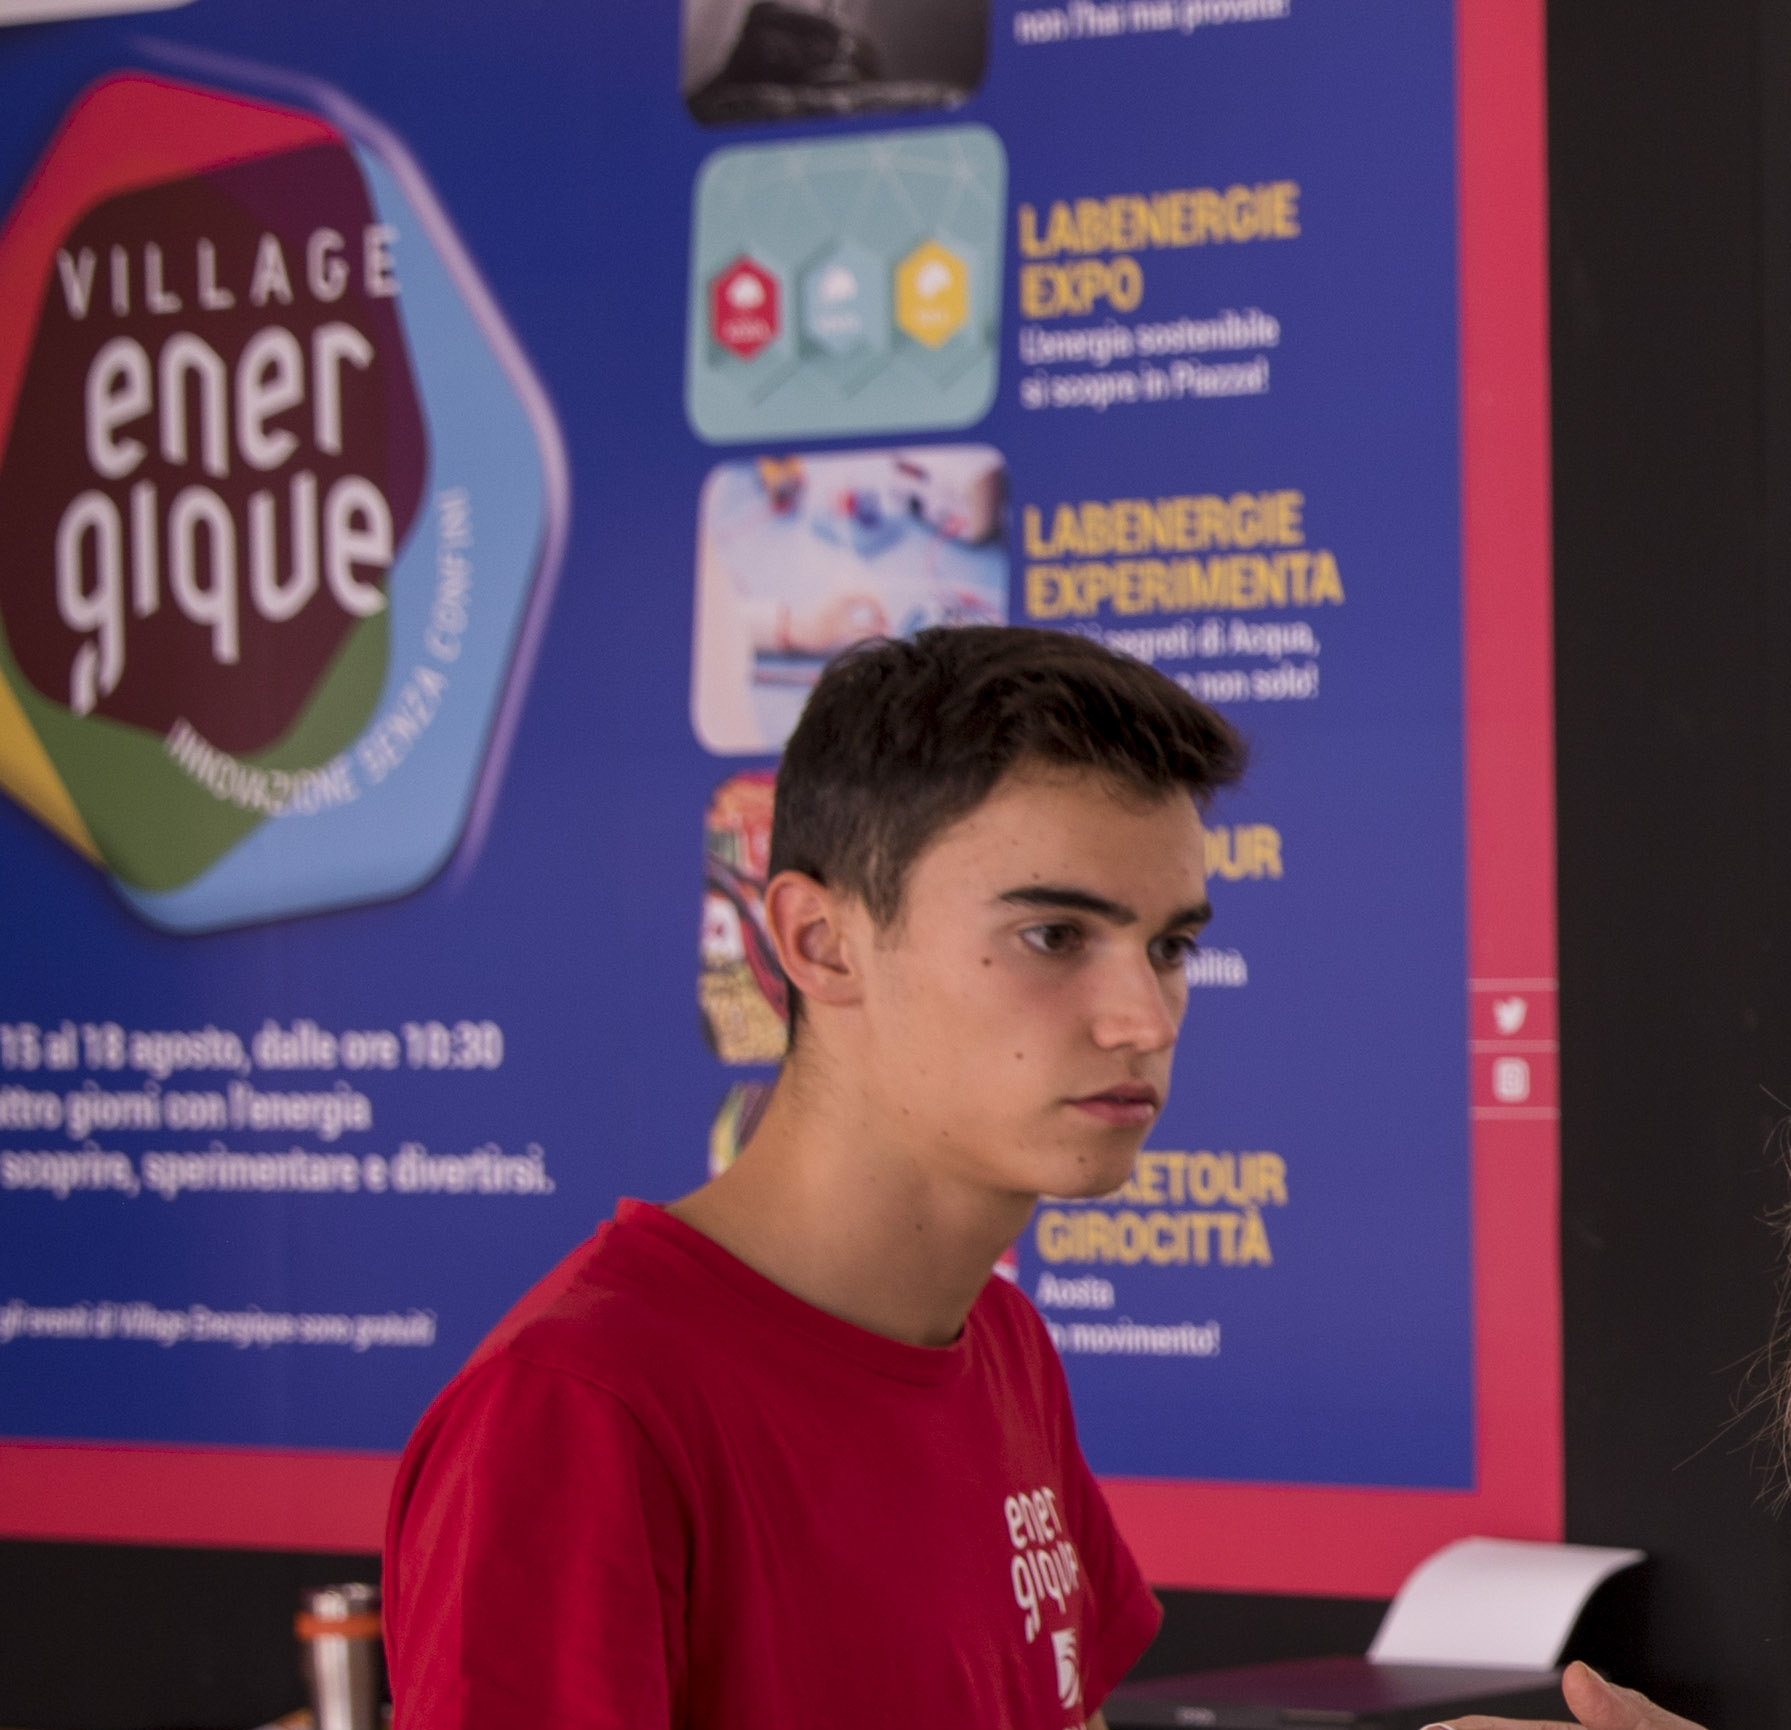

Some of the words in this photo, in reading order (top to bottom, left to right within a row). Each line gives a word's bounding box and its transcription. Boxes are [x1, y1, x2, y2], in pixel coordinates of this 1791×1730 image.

[1018, 179, 1301, 259] LABENERGIE
[57, 224, 401, 320] VILLAGE
[1019, 254, 1144, 319] EXPO
[1134, 307, 1281, 356] sostenibile
[84, 320, 376, 480] ener
[1022, 489, 1306, 560] LABENERGIE
[54, 469, 395, 718] gique
[1024, 549, 1347, 619] EXPERIMENTA
[44, 1019, 79, 1071] al
[81, 1020, 128, 1071] 18
[128, 1024, 252, 1080] agosto,
[251, 1018, 338, 1070] dalle
[339, 1031, 401, 1070] ore
[402, 1020, 504, 1070] 10:30
[65, 1079, 162, 1141] giorni
[162, 1090, 228, 1131] con
[140, 1139, 360, 1200] sperimentare
[361, 1153, 390, 1192] e
[391, 1142, 556, 1194] divertirsi.
[1036, 1204, 1274, 1267] GIROCITTÀ
[1036, 1270, 1116, 1310] Aosta
[1064, 1316, 1221, 1357] movimento!
[1003, 1486, 1063, 1551] ener
